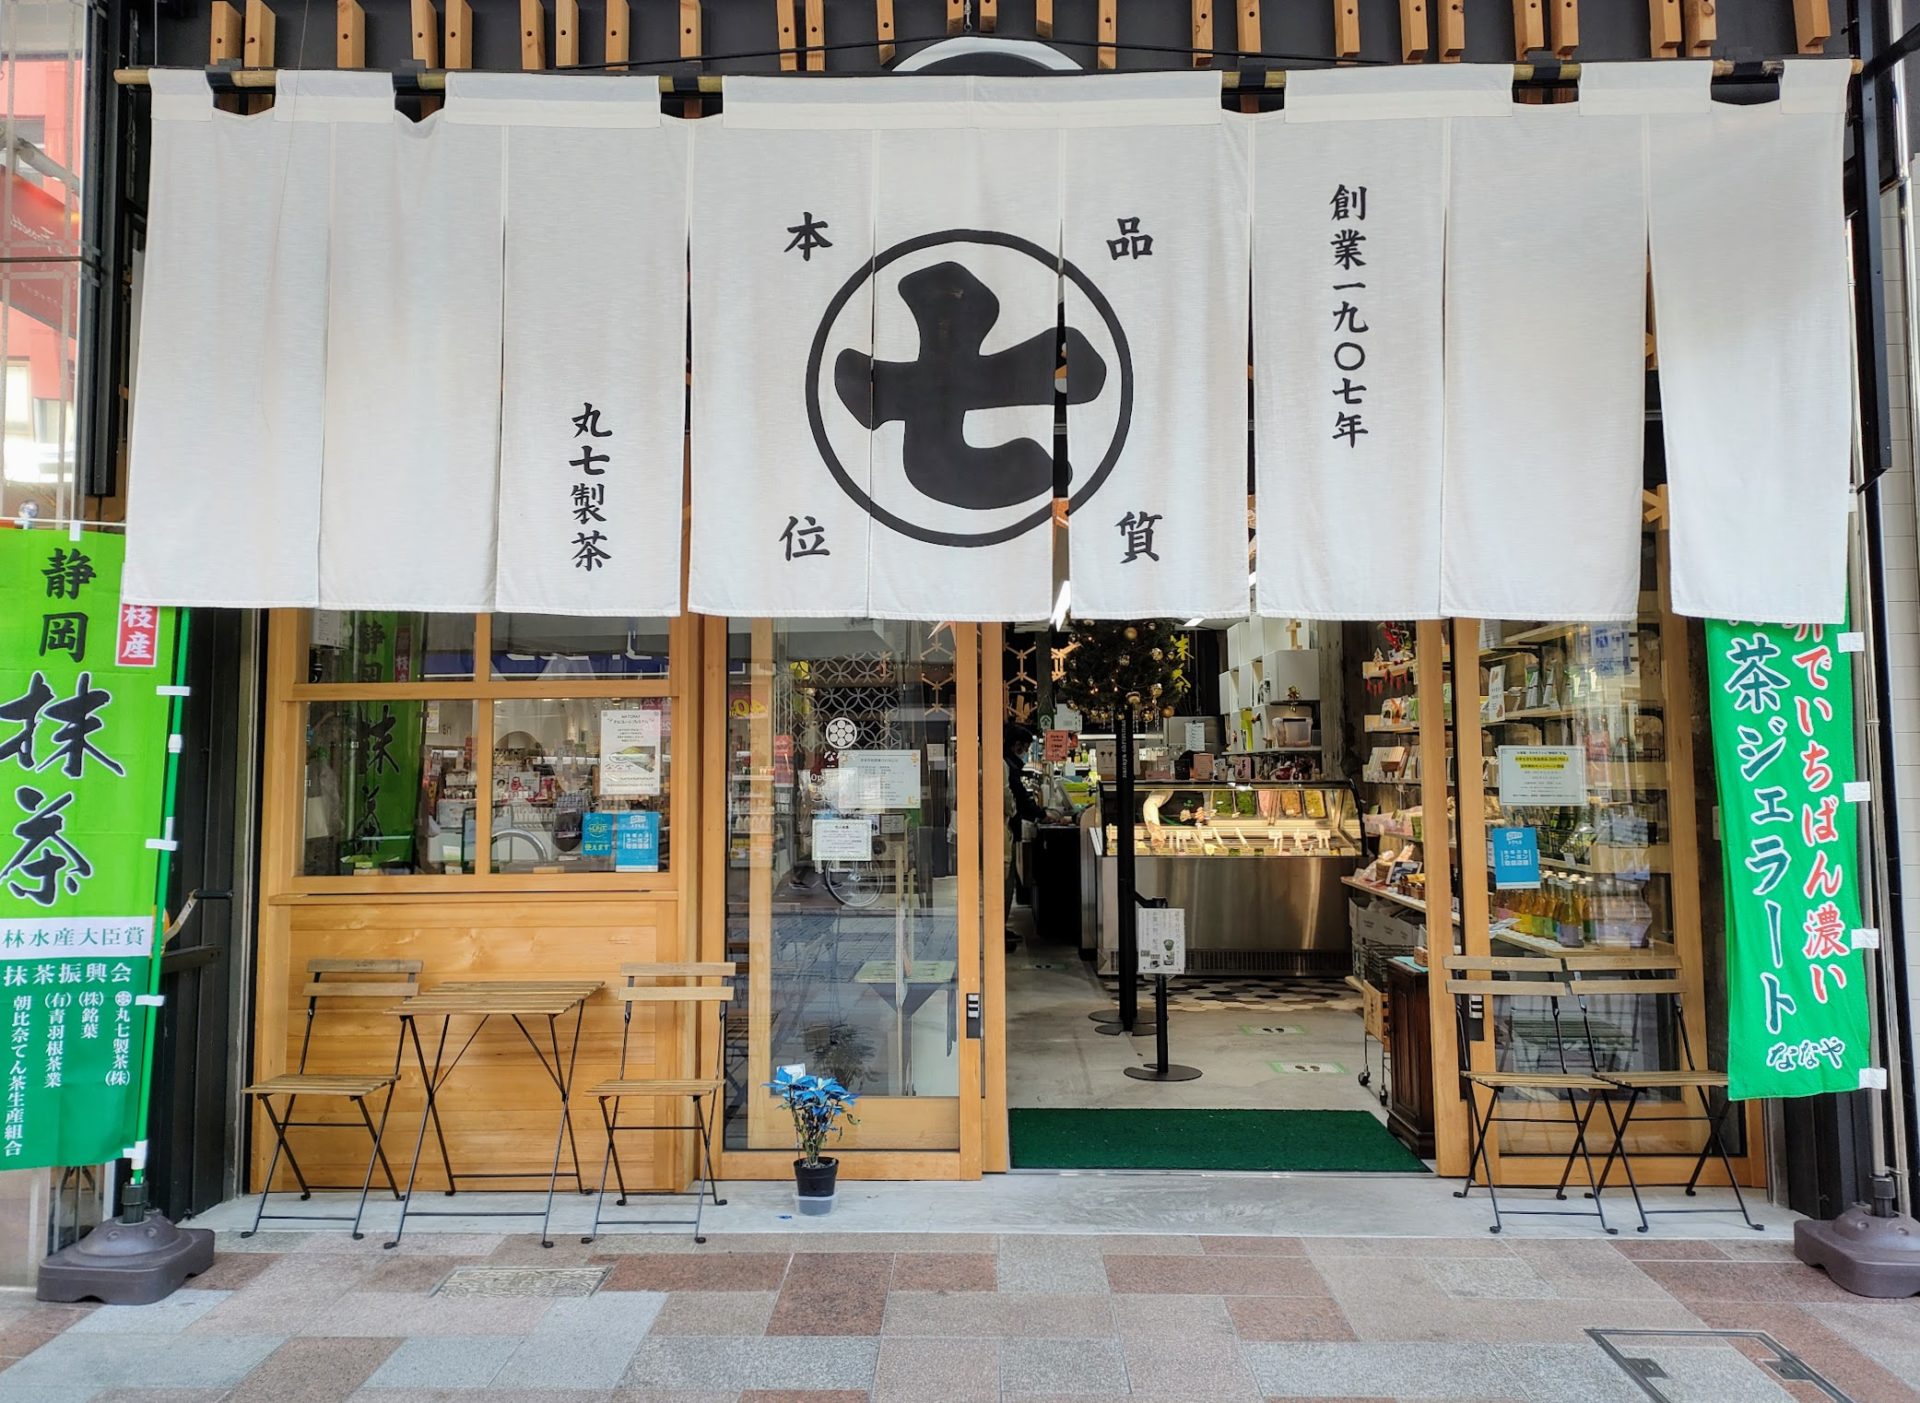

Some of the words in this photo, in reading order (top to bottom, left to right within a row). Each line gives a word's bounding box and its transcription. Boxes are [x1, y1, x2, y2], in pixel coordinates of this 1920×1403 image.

[784, 211, 833, 262] 本
[1106, 217, 1153, 261] 品
[1329, 184, 1369, 449] 創業一九〇七年
[568, 402, 613, 572] 丸七製茶
[778, 515, 831, 562] 位
[1114, 511, 1163, 564] 質
[38, 547, 97, 664] 静岡
[0, 671, 126, 906] 抹茶
[1726, 621, 1794, 1032] 茶ジェラート
[3, 962, 132, 987] 抹茶振興会
[1767, 1036, 1845, 1071] ななや
